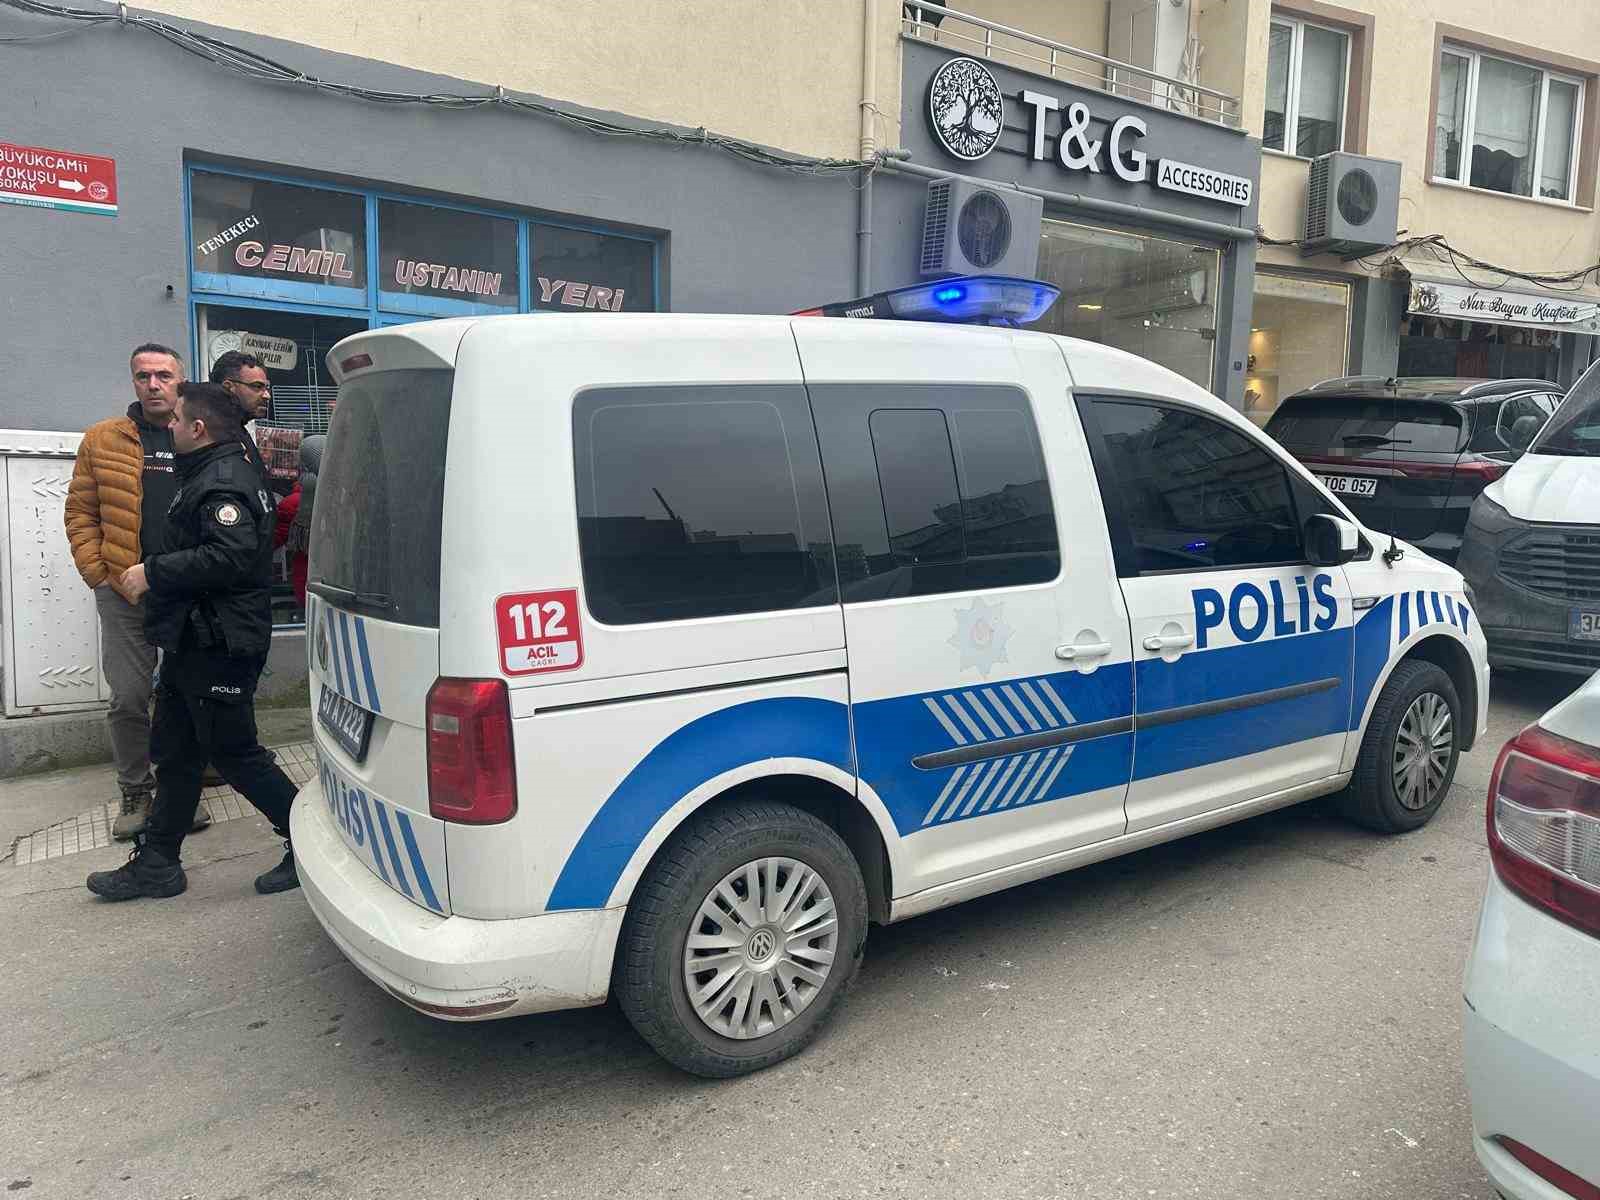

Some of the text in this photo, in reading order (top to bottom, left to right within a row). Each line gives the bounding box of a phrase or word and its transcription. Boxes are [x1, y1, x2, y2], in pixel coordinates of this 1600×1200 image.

[1023, 90, 1249, 201] T&G ACCESSORIES
[197, 215, 260, 256] TENEKECİ
[235, 240, 625, 312] CEMİL USTANIN YERİ
[1459, 291, 1579, 322] Nur Bayan Kuaförü
[1323, 477, 1376, 493] TOG 057
[508, 600, 569, 640] 112
